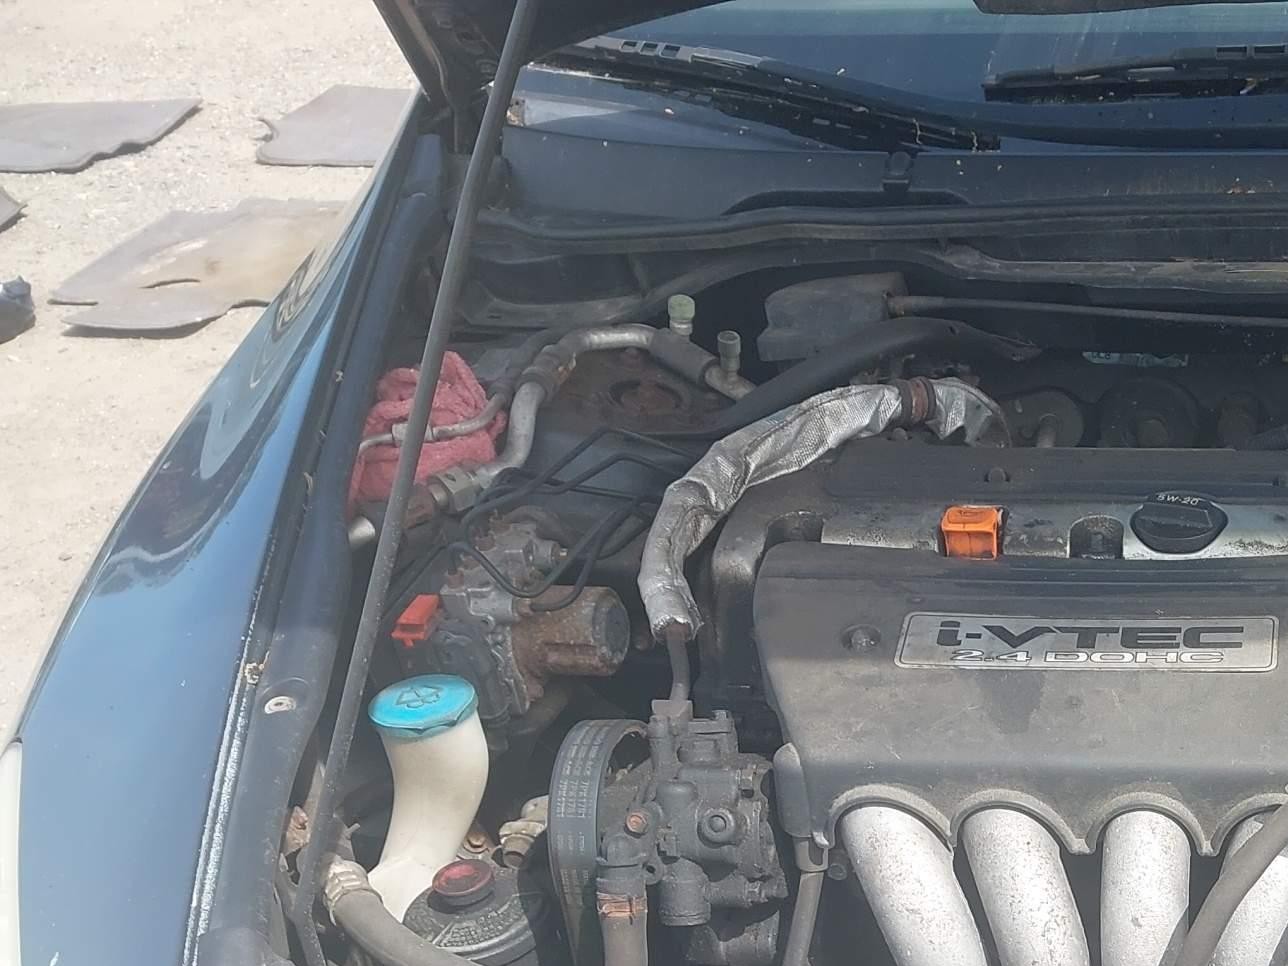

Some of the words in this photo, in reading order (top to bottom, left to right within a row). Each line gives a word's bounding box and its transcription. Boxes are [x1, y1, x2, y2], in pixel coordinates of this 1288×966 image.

[935, 620, 1245, 649] i-VTEC
[949, 648, 1032, 663] 2.4
[1043, 650, 1226, 664] DOHC
